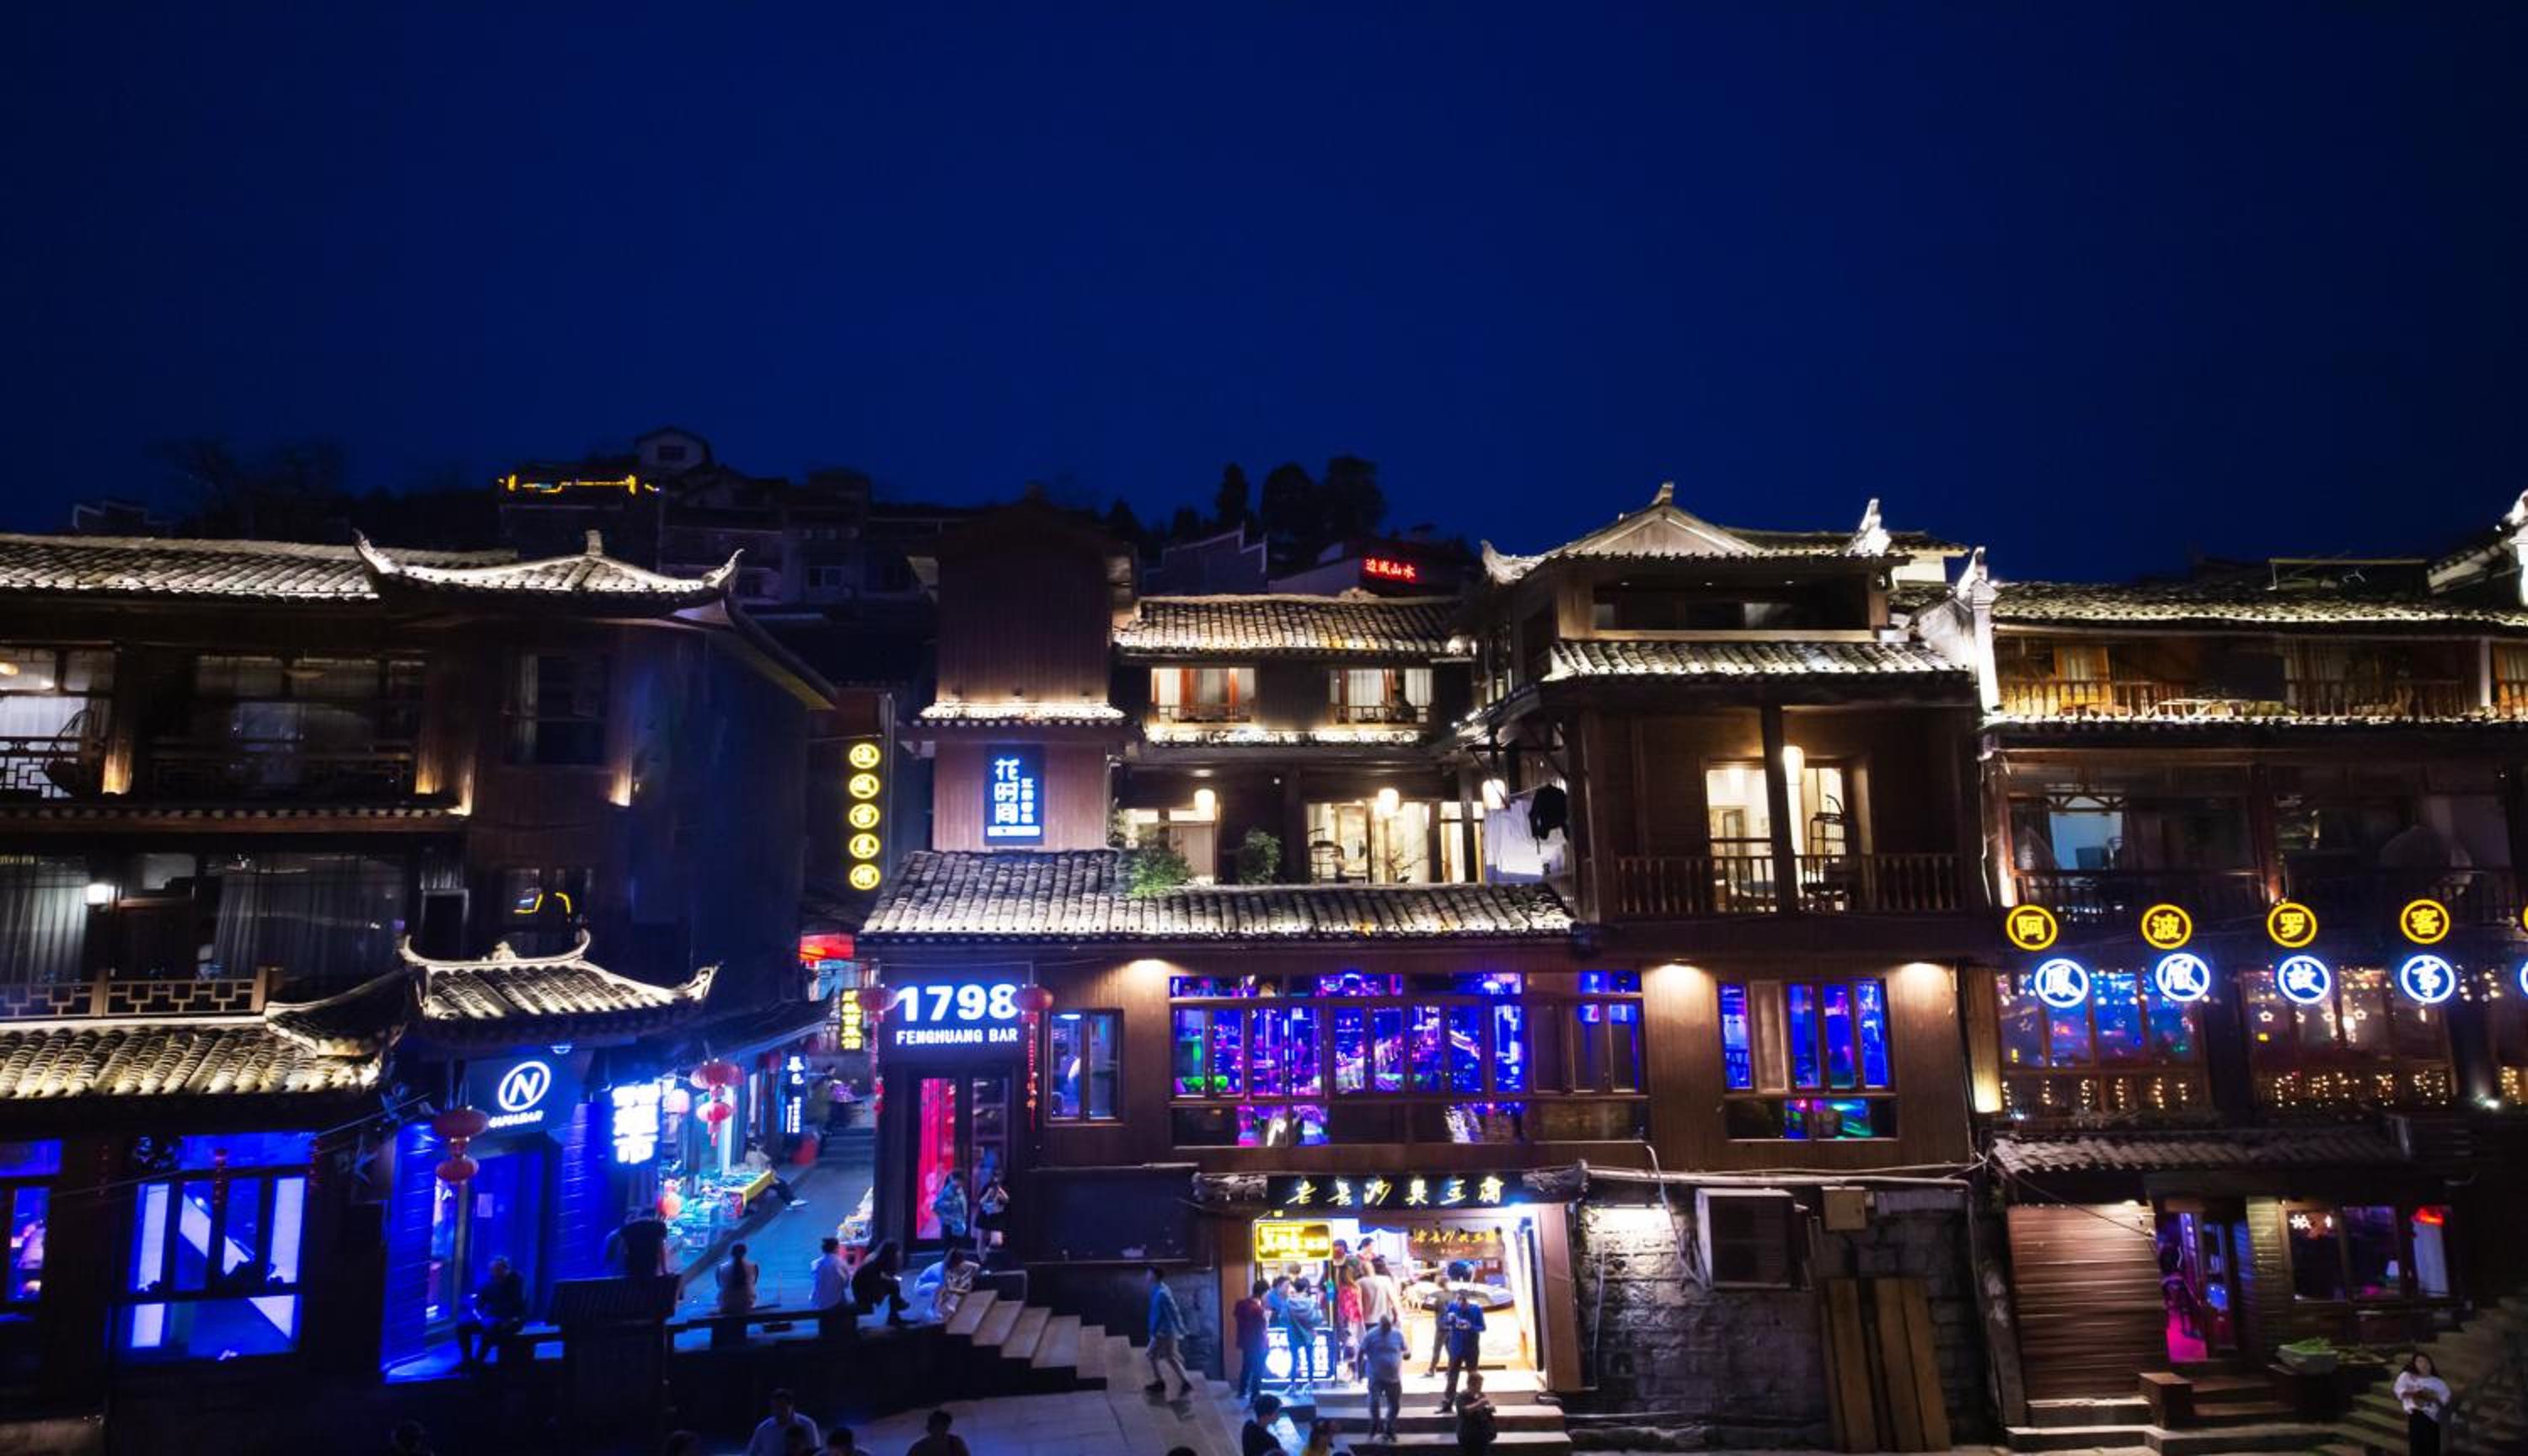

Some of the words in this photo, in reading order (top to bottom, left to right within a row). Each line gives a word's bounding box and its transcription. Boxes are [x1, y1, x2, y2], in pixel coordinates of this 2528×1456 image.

[897, 984, 1019, 1021] 1798
[897, 1028, 983, 1045] FENGHUANG
[989, 1027, 1018, 1042] BAR
